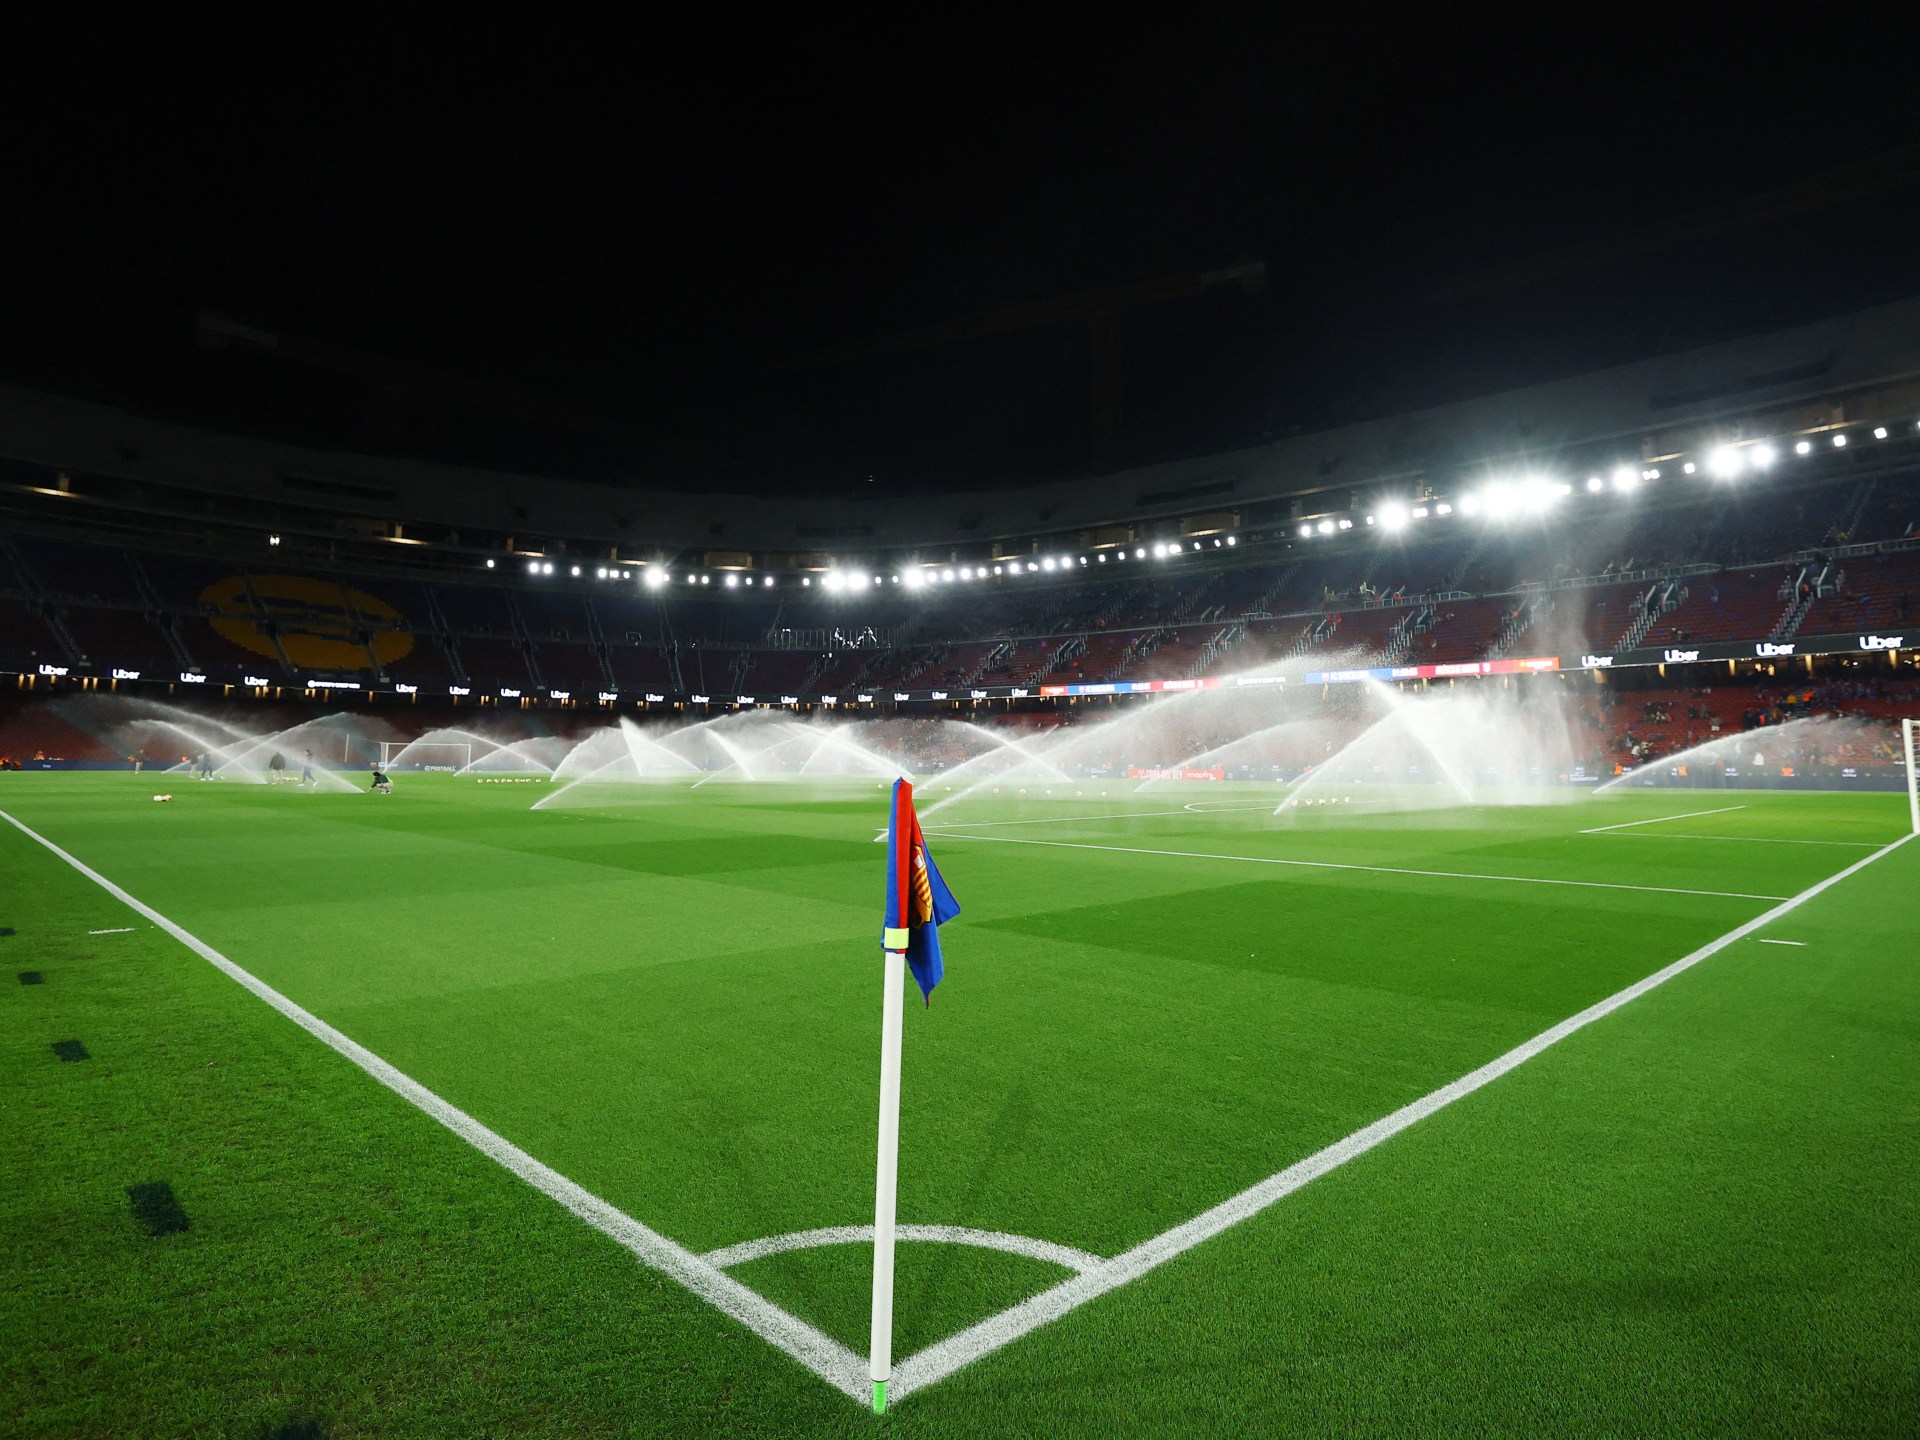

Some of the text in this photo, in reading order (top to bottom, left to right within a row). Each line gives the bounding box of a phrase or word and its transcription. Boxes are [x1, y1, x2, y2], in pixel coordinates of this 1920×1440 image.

[1859, 636, 1903, 649] Uber
[1756, 643, 1795, 657] Uber
[1664, 650, 1699, 662] Uber
[1581, 655, 1613, 667] Uber
[39, 665, 68, 675] Uber
[113, 669, 140, 679] Uber
[181, 673, 206, 683] Uber
[245, 676, 269, 686] Uber
[396, 684, 417, 693] Uber
[450, 687, 470, 695] Uber
[501, 689, 520, 697] Uber
[1012, 689, 1028, 697] Uber
[551, 690, 569, 699] Uber
[599, 692, 617, 700] Uber
[646, 694, 664, 702] Uber
[895, 693, 909, 701] Uber
[971, 690, 987, 698] Uber
[692, 695, 709, 703] Uber
